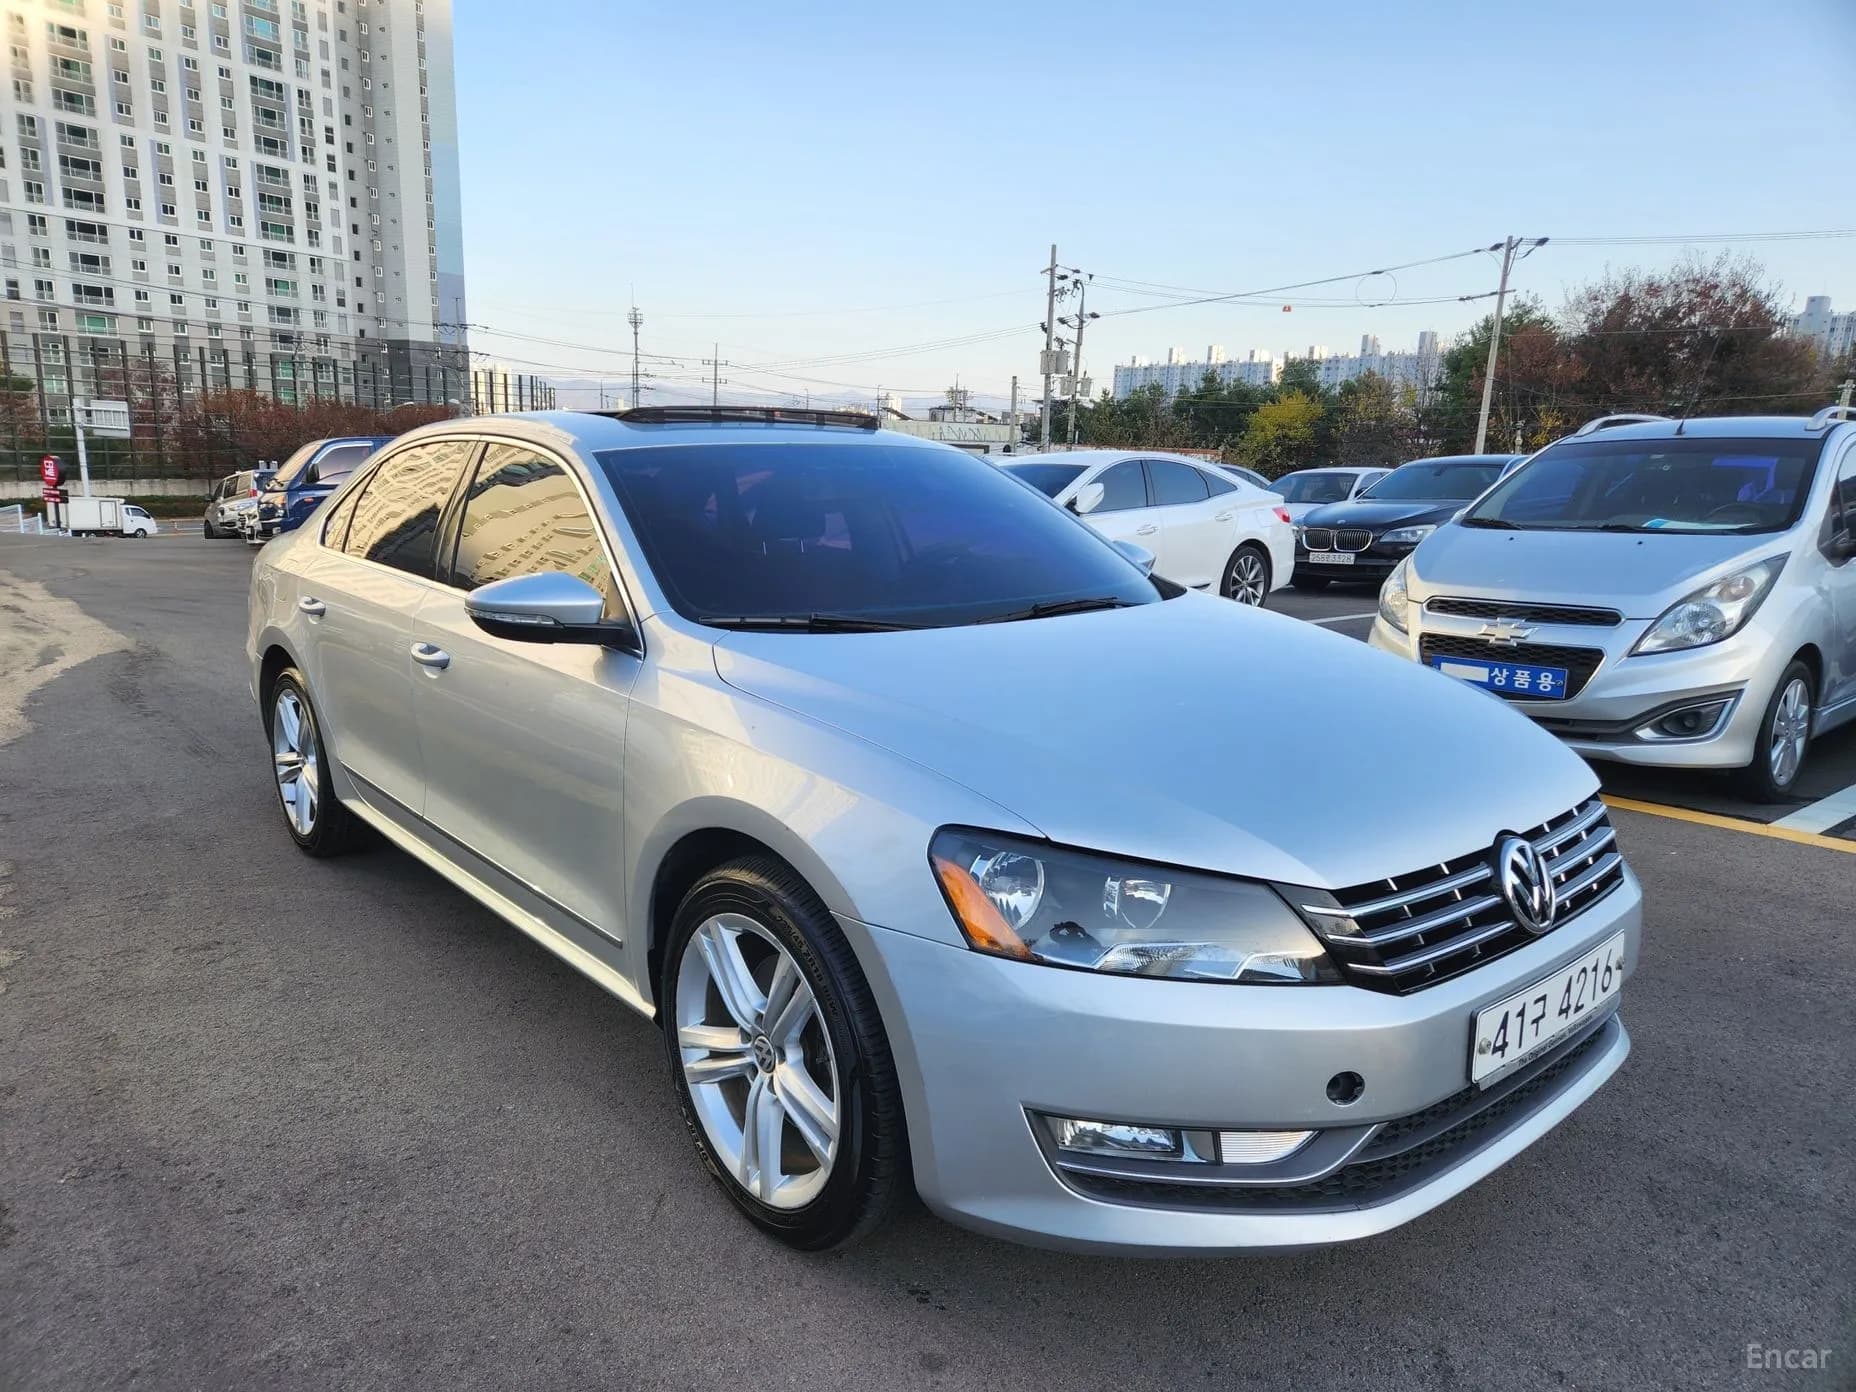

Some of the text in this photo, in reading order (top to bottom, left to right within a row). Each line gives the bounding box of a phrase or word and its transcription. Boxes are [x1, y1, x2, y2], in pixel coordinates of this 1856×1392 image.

[1490, 667, 1556, 692] 상품용
[1491, 948, 1612, 1058] 41구 4216
